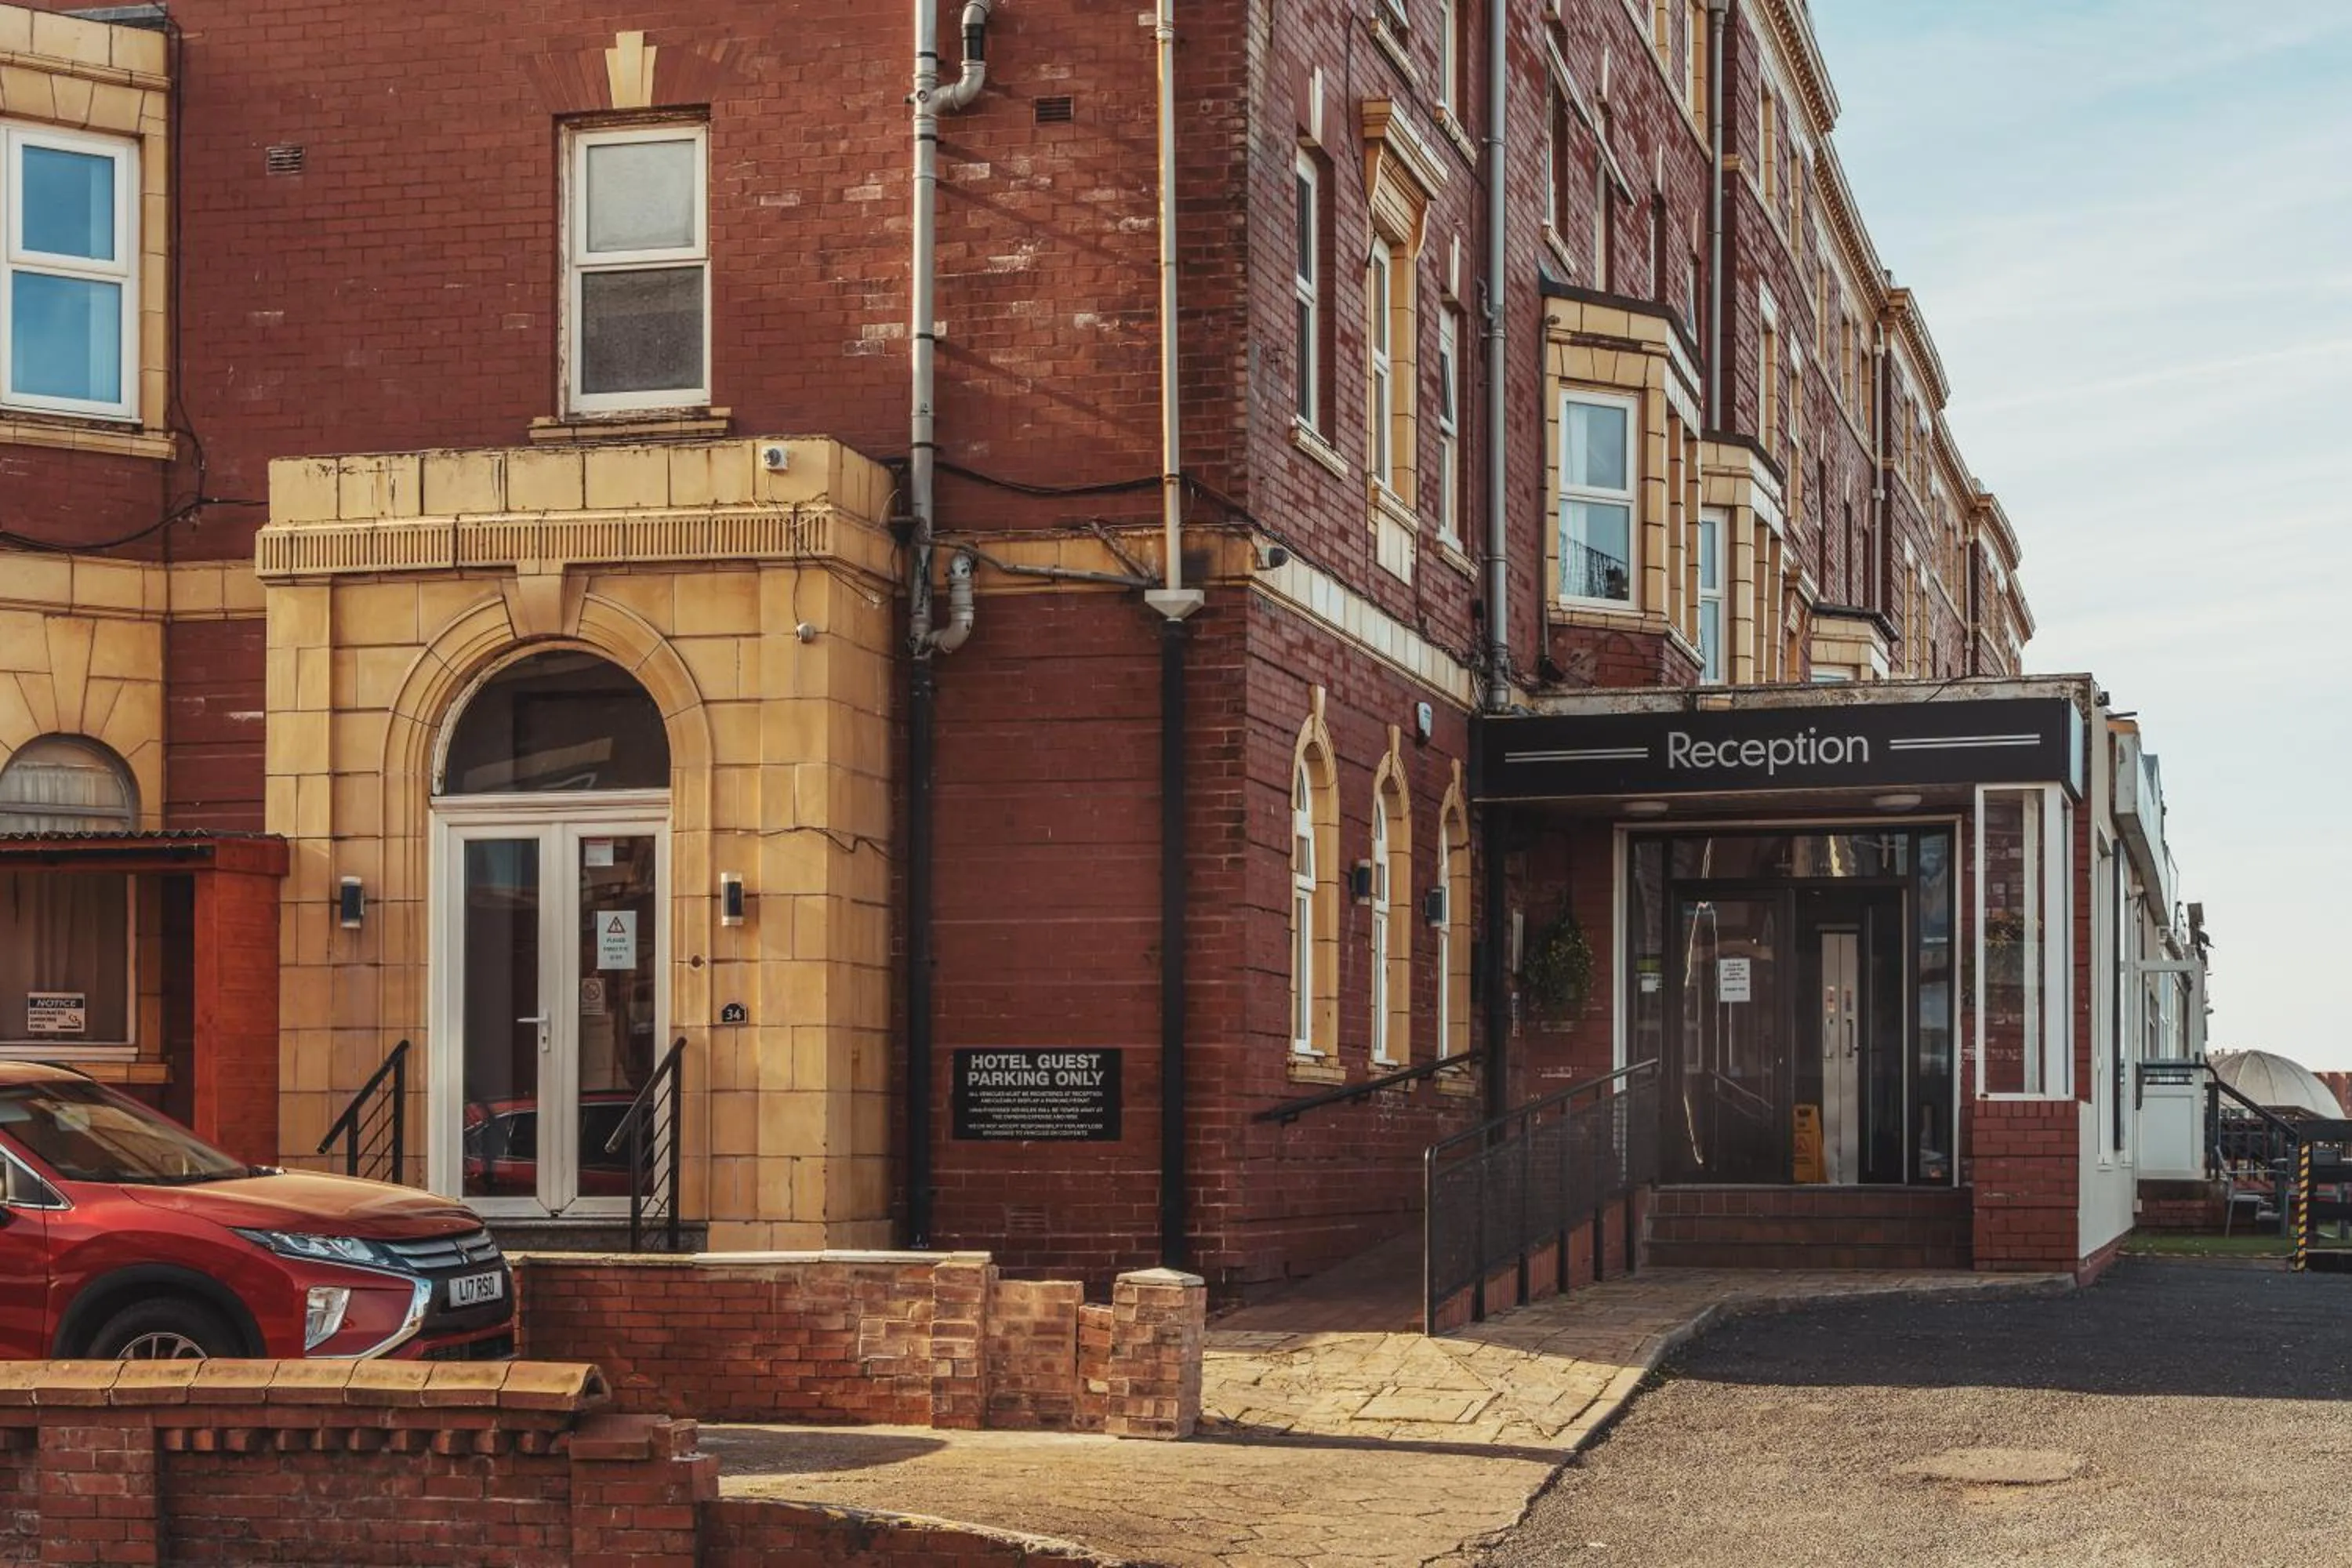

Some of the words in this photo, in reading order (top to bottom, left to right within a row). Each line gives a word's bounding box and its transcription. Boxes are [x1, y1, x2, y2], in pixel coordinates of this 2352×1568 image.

[1668, 728, 1869, 775] Reception
[728, 1009, 741, 1020] 34
[971, 1054, 1031, 1069] HOTEL
[1037, 1054, 1101, 1069] GUEST
[967, 1071, 1050, 1087] PARKING
[1055, 1071, 1104, 1086] ONLY
[459, 1279, 474, 1301] L17
